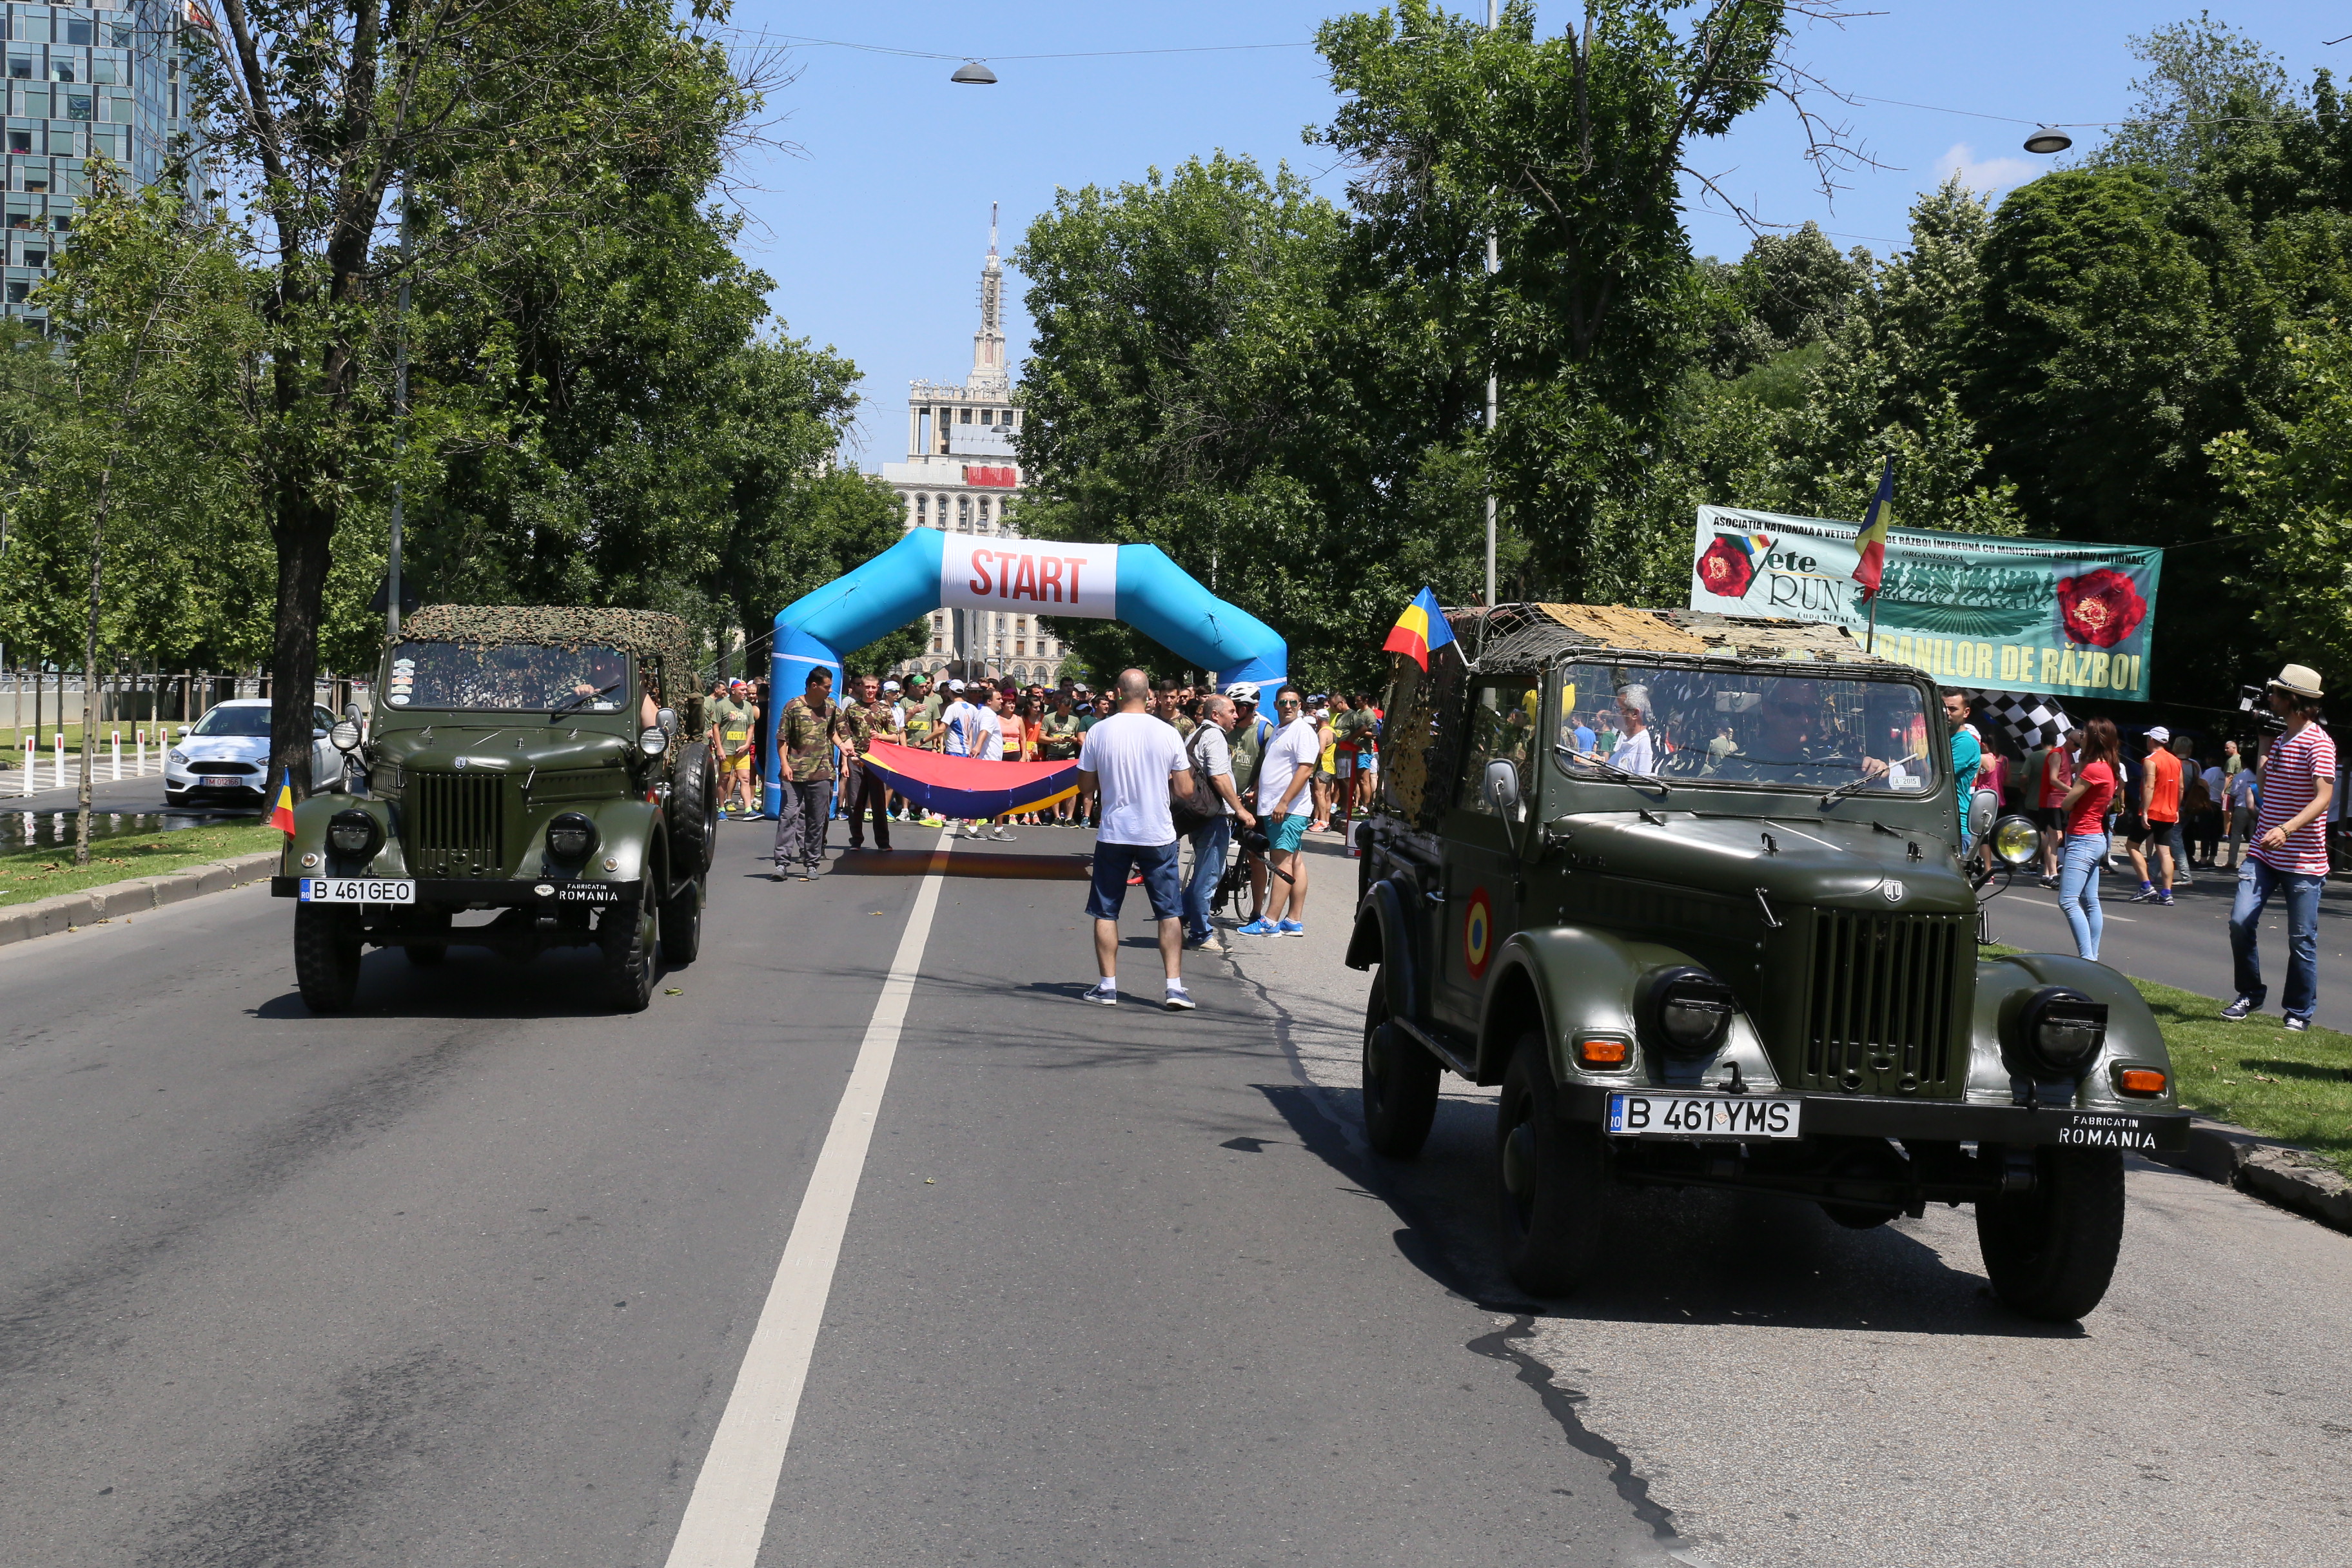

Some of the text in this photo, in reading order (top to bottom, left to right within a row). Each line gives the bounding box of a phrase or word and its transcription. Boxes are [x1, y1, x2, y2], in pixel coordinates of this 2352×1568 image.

[1714, 516, 1762, 532] ASOCIAȚIA
[1764, 522, 1814, 536] NAȚIONALĂ
[1816, 528, 1823, 537] A
[1825, 529, 1858, 540] VETERA
[1886, 535, 1897, 544] DE
[1899, 535, 1932, 548] RĂZBOI
[1933, 538, 1981, 553] ÎMPREUNĂ
[1983, 544, 1995, 553] CU
[1997, 545, 2052, 558] MINISTERUL
[2097, 553, 2146, 565] NAȚIONALE
[1901, 550, 1964, 562] ORGANIZEAZĂ
[970, 549, 1088, 604] START
[1767, 574, 1843, 613] RUN
[1797, 611, 1819, 620] Cupa
[2000, 645, 2035, 683] DE
[2040, 642, 2141, 691] RĂZBOI
[314, 881, 328, 899] B
[559, 890, 618, 901] ROMANIA
[1627, 1097, 1651, 1128] B
[2059, 1128, 2156, 1150] ROMANIA
